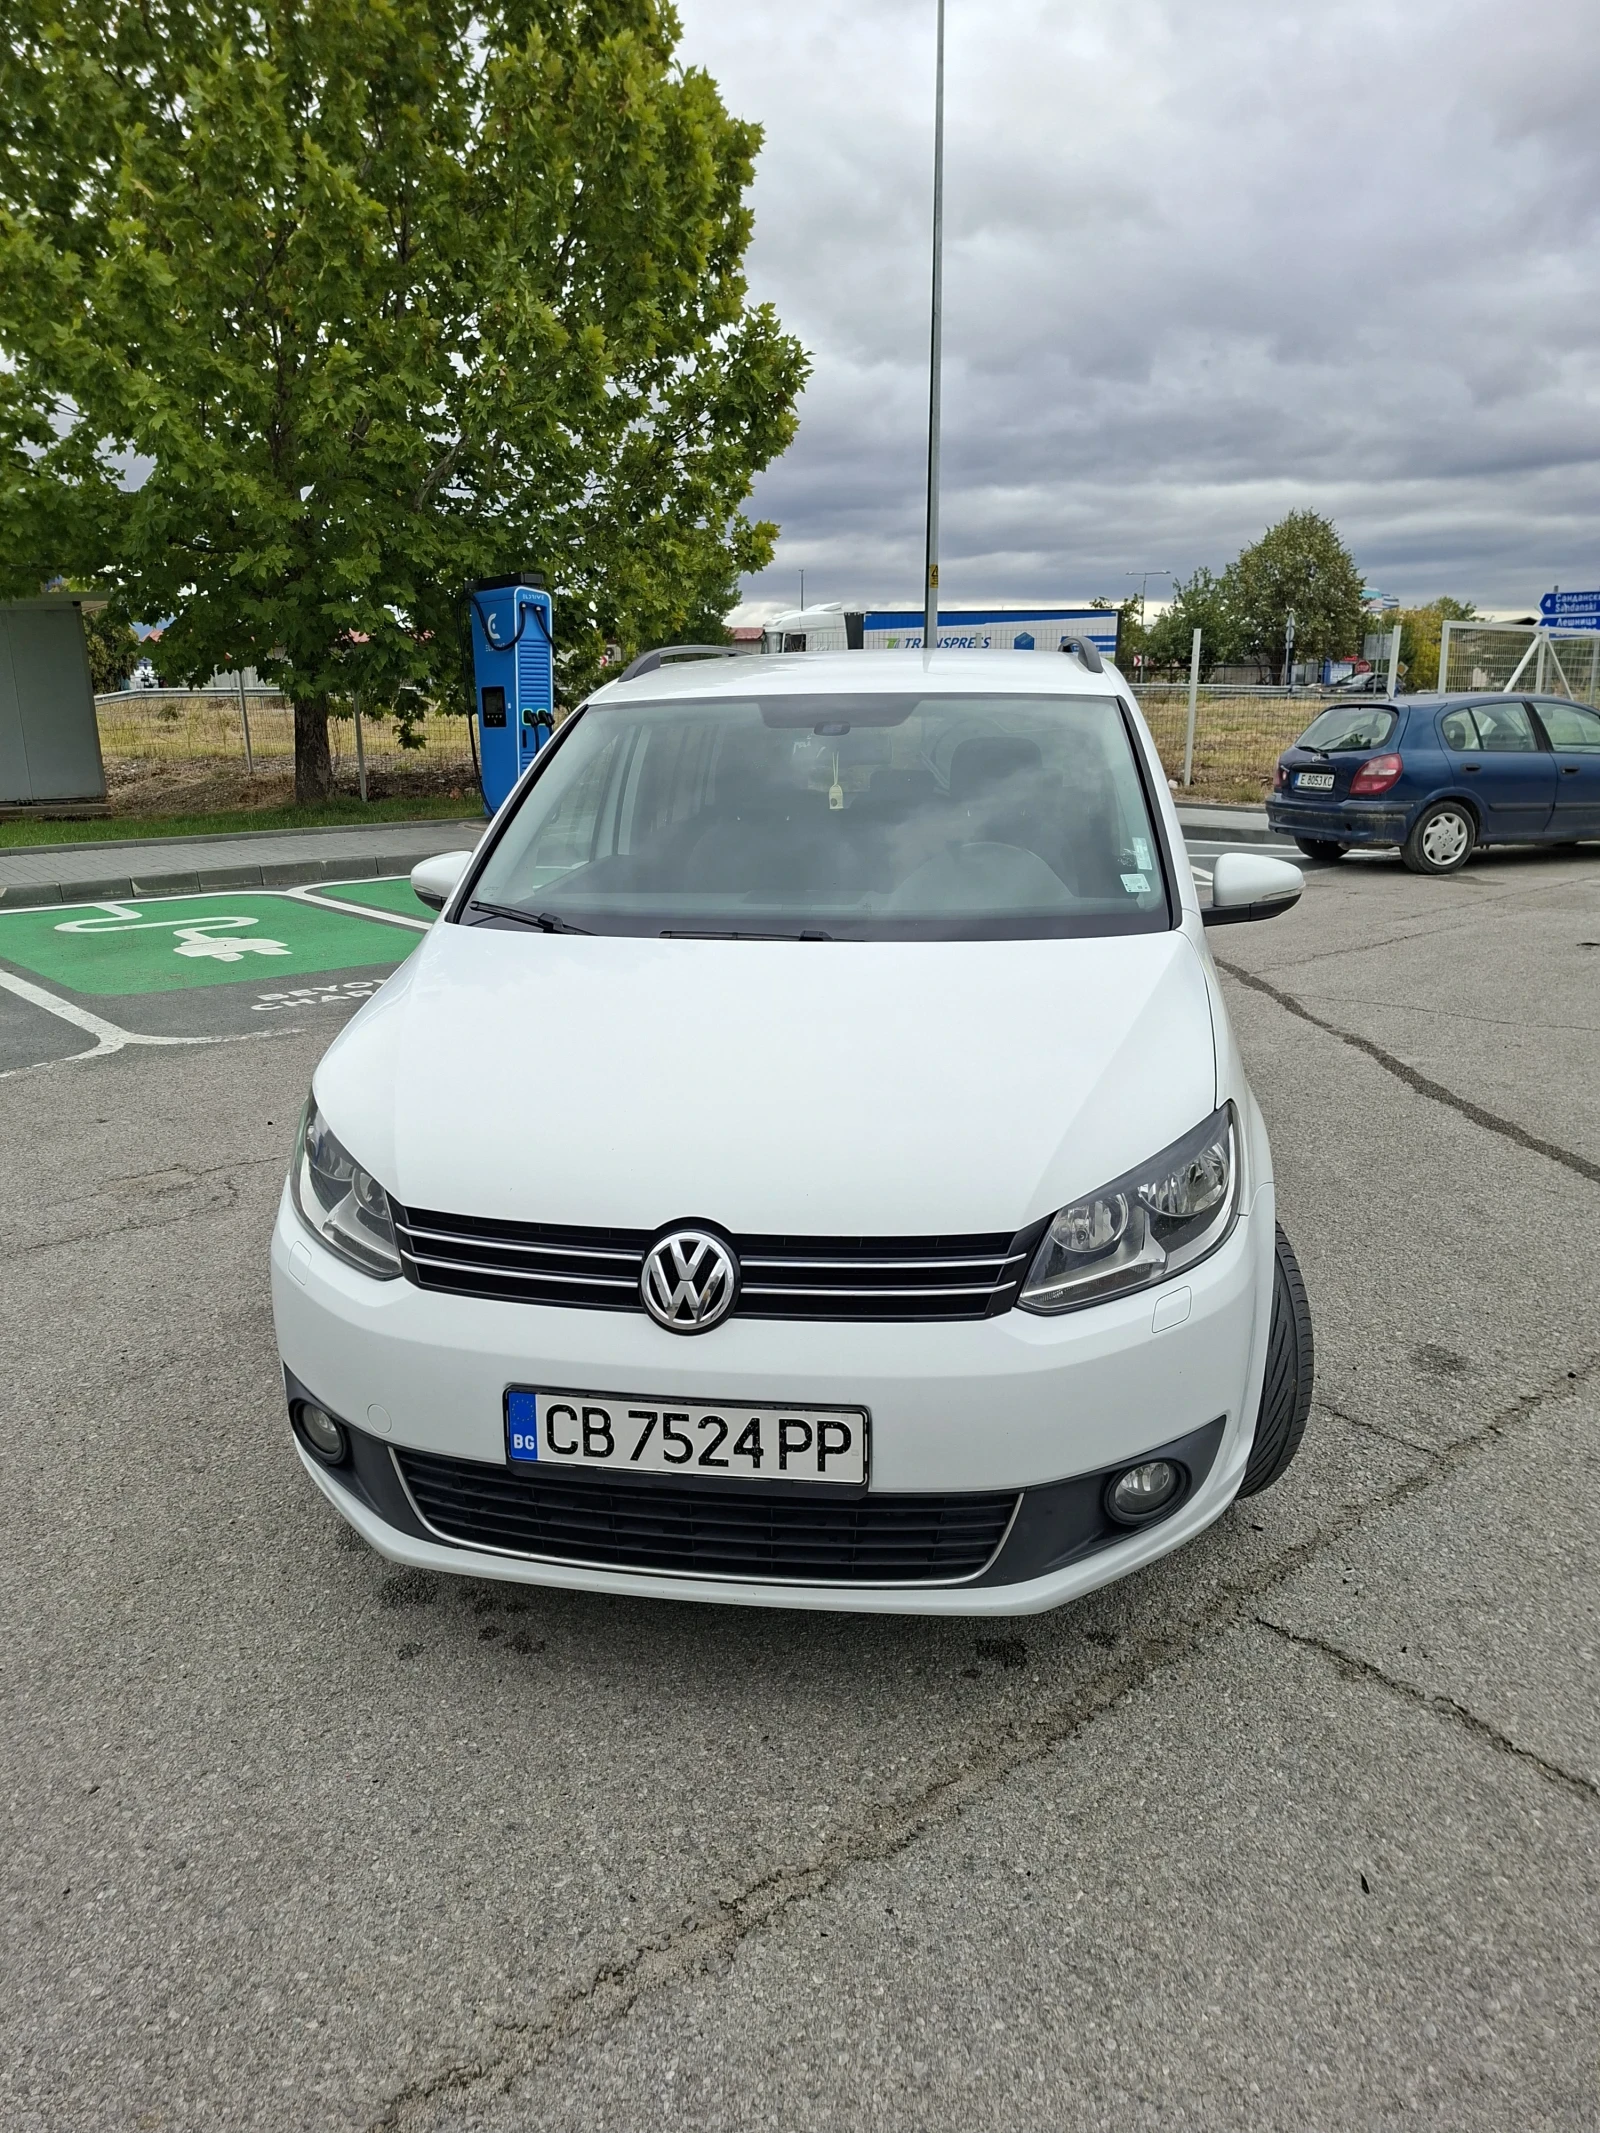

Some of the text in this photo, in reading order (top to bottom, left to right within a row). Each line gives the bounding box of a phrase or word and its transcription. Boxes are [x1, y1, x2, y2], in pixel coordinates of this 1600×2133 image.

[1555, 594, 1600, 602] Санданск
[1556, 618, 1597, 626] Лешница
[905, 637, 991, 649] TRNSPRES
[513, 1434, 535, 1450] BG
[546, 1403, 852, 1472] CB 7524 PP
